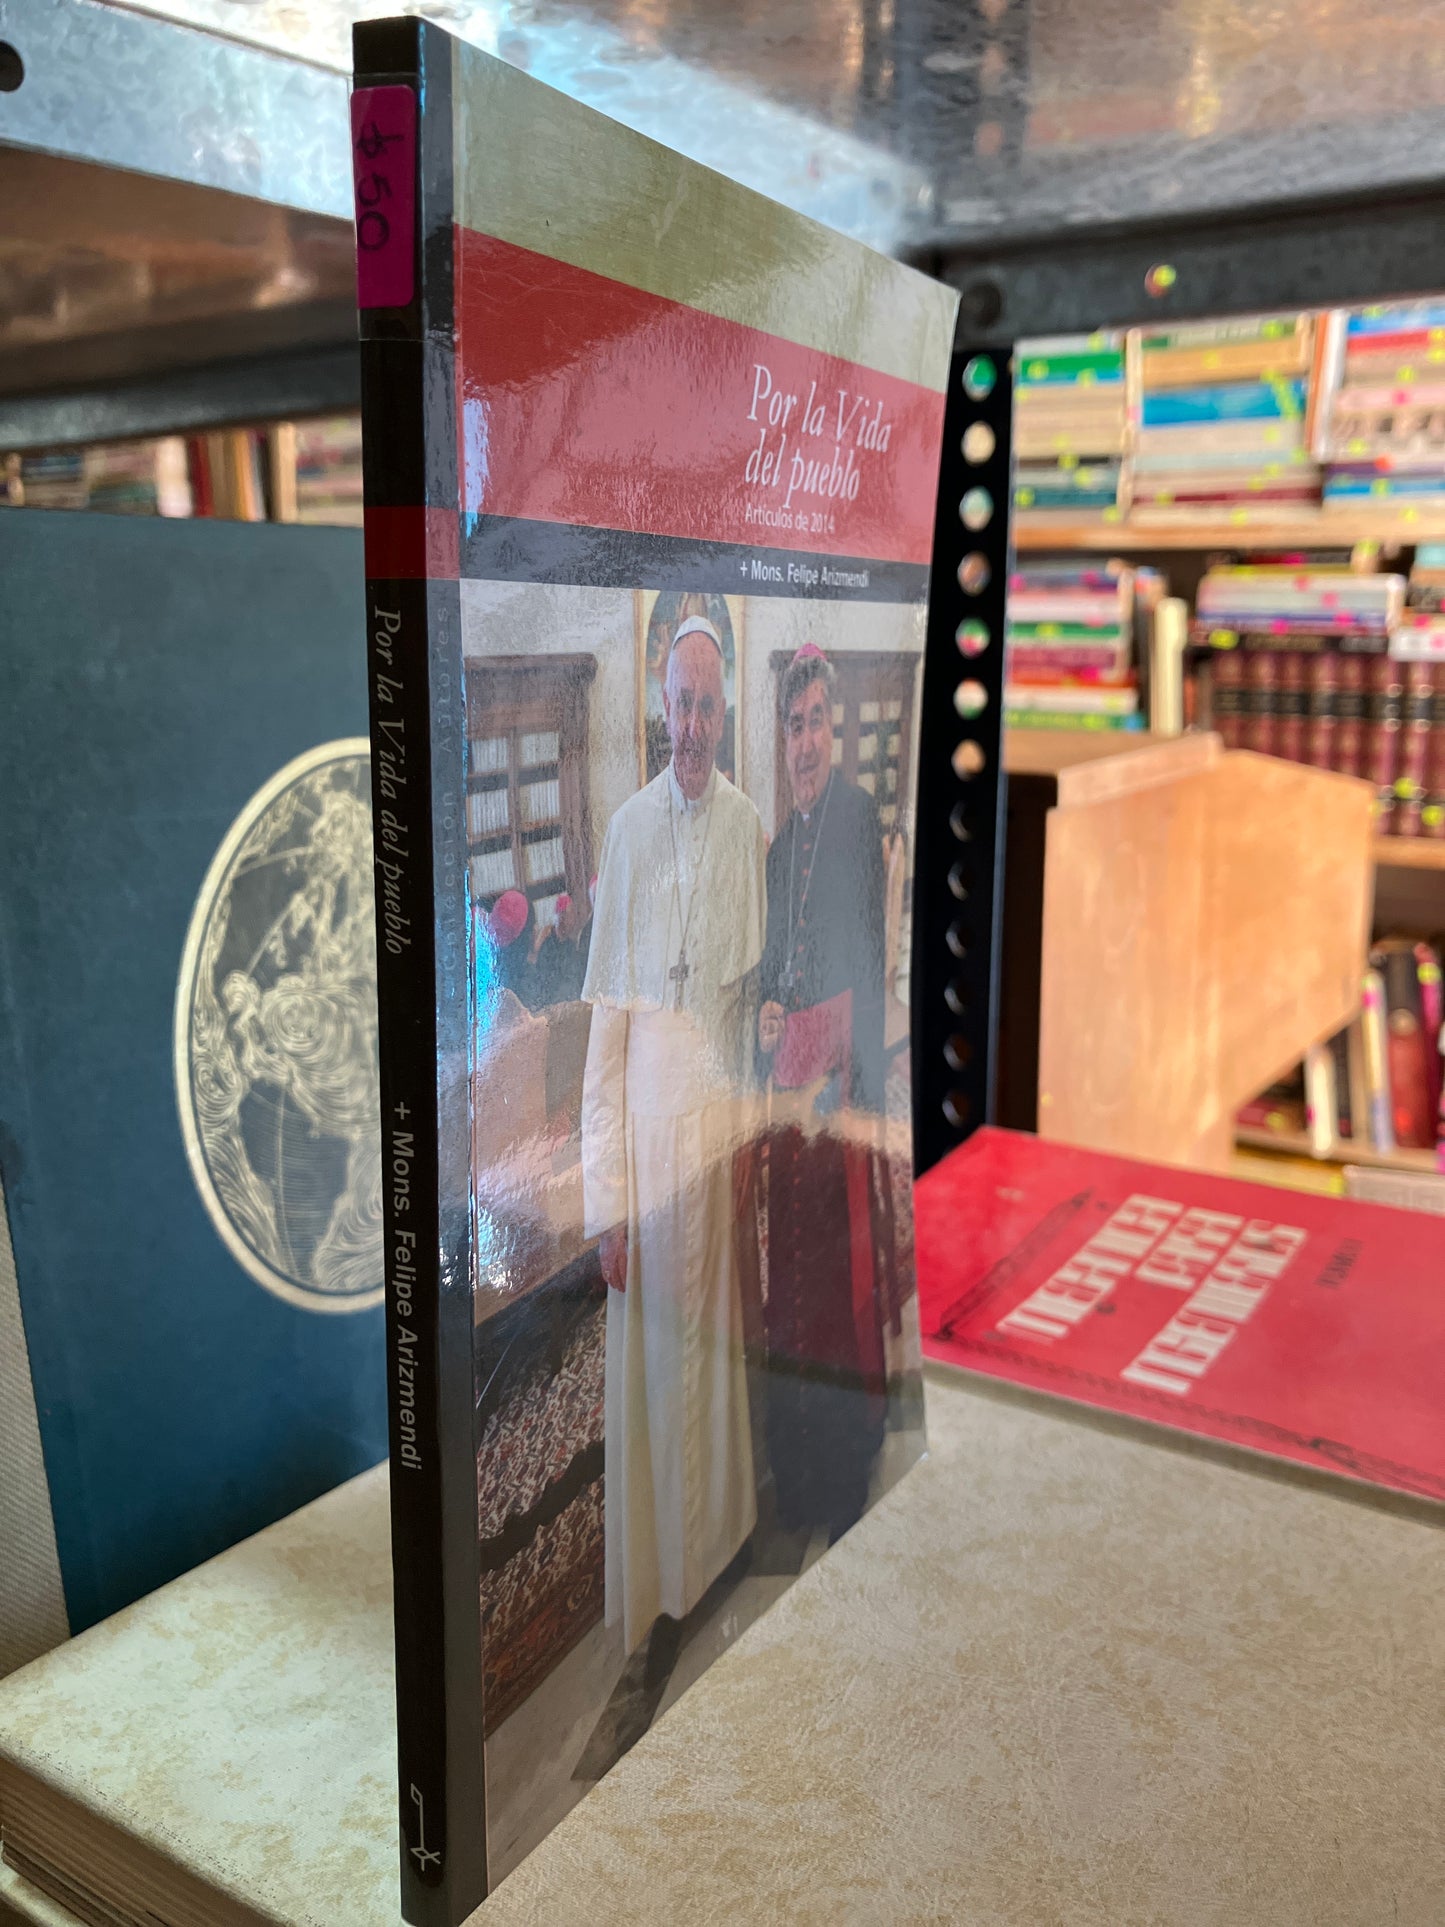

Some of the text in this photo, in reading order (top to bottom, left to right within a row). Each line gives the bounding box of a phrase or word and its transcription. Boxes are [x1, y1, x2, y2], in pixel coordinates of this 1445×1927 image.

[746, 363, 892, 453] Por la Vida
[744, 428, 861, 509] del pueblo
[794, 510, 809, 532] de
[810, 512, 836, 534] 2014
[751, 559, 784, 583] Mons.
[786, 562, 819, 588] Felipe
[820, 566, 870, 588] Arizmendi
[374, 604, 412, 954] Por la Vida del pueblo
[392, 1130, 415, 1218] Mons.
[392, 1229, 417, 1317] Felipe
[396, 1323, 423, 1470] Arizmendi
